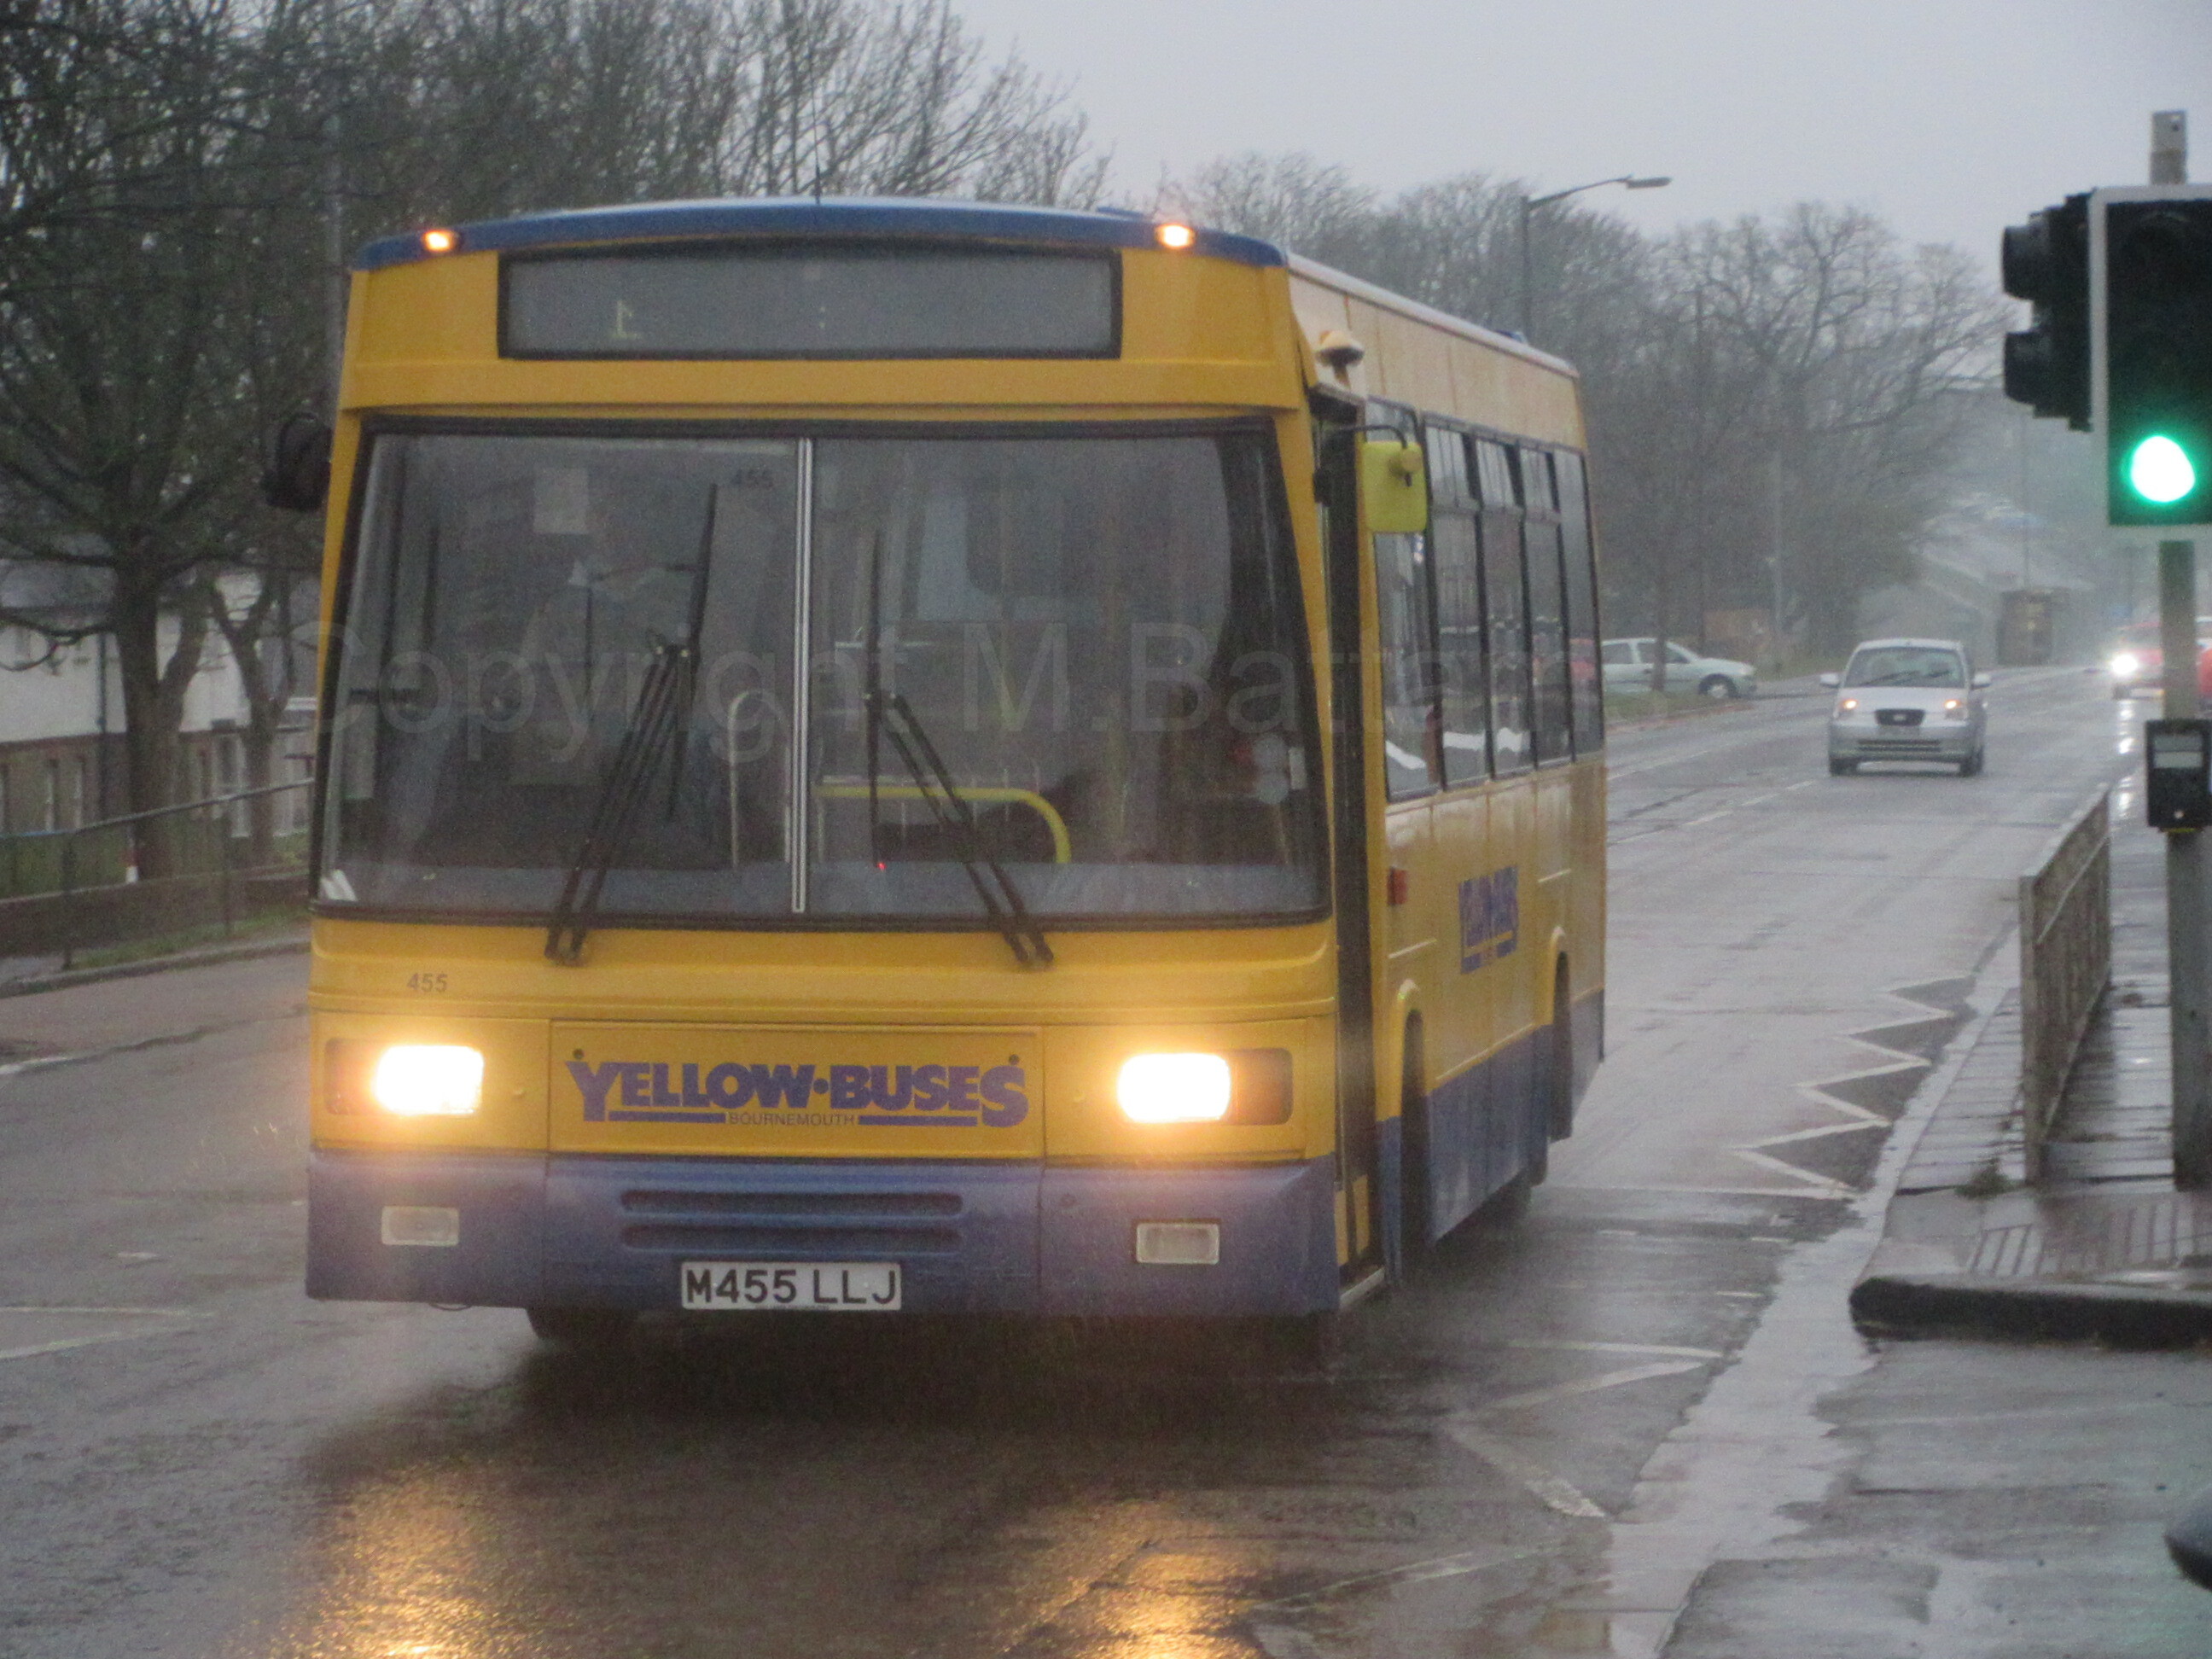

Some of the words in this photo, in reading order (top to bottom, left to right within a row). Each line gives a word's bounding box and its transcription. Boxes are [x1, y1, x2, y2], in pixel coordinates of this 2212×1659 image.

[406, 973, 448, 992] 455
[730, 1114, 855, 1127] BOURNEMOUTH
[686, 1269, 797, 1304] M455
[812, 1269, 897, 1304] LLJ
